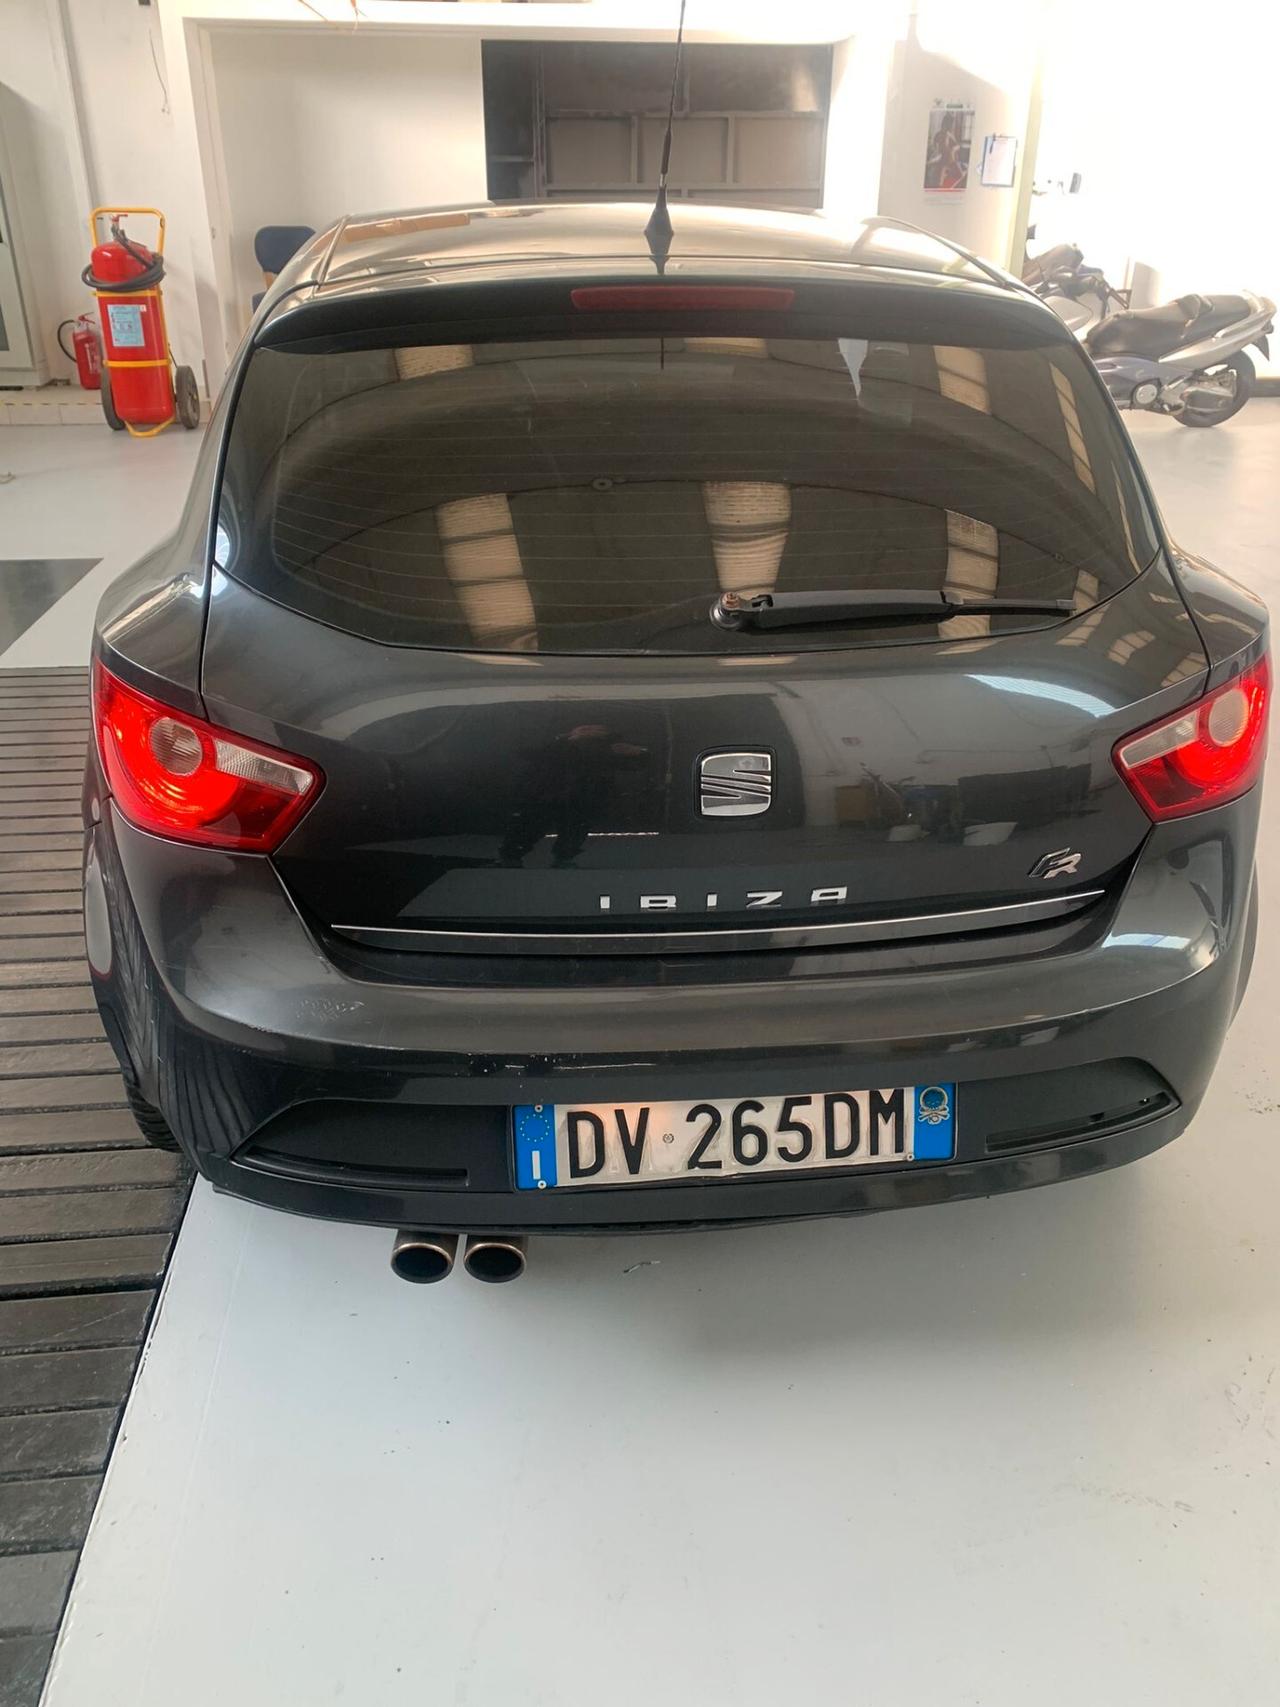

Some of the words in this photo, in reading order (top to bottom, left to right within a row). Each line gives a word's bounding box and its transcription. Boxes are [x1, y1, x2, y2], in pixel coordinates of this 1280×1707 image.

[600, 886, 848, 909] IBIZA
[566, 1107, 650, 1178] DV
[685, 1089, 905, 1170] 265DM
